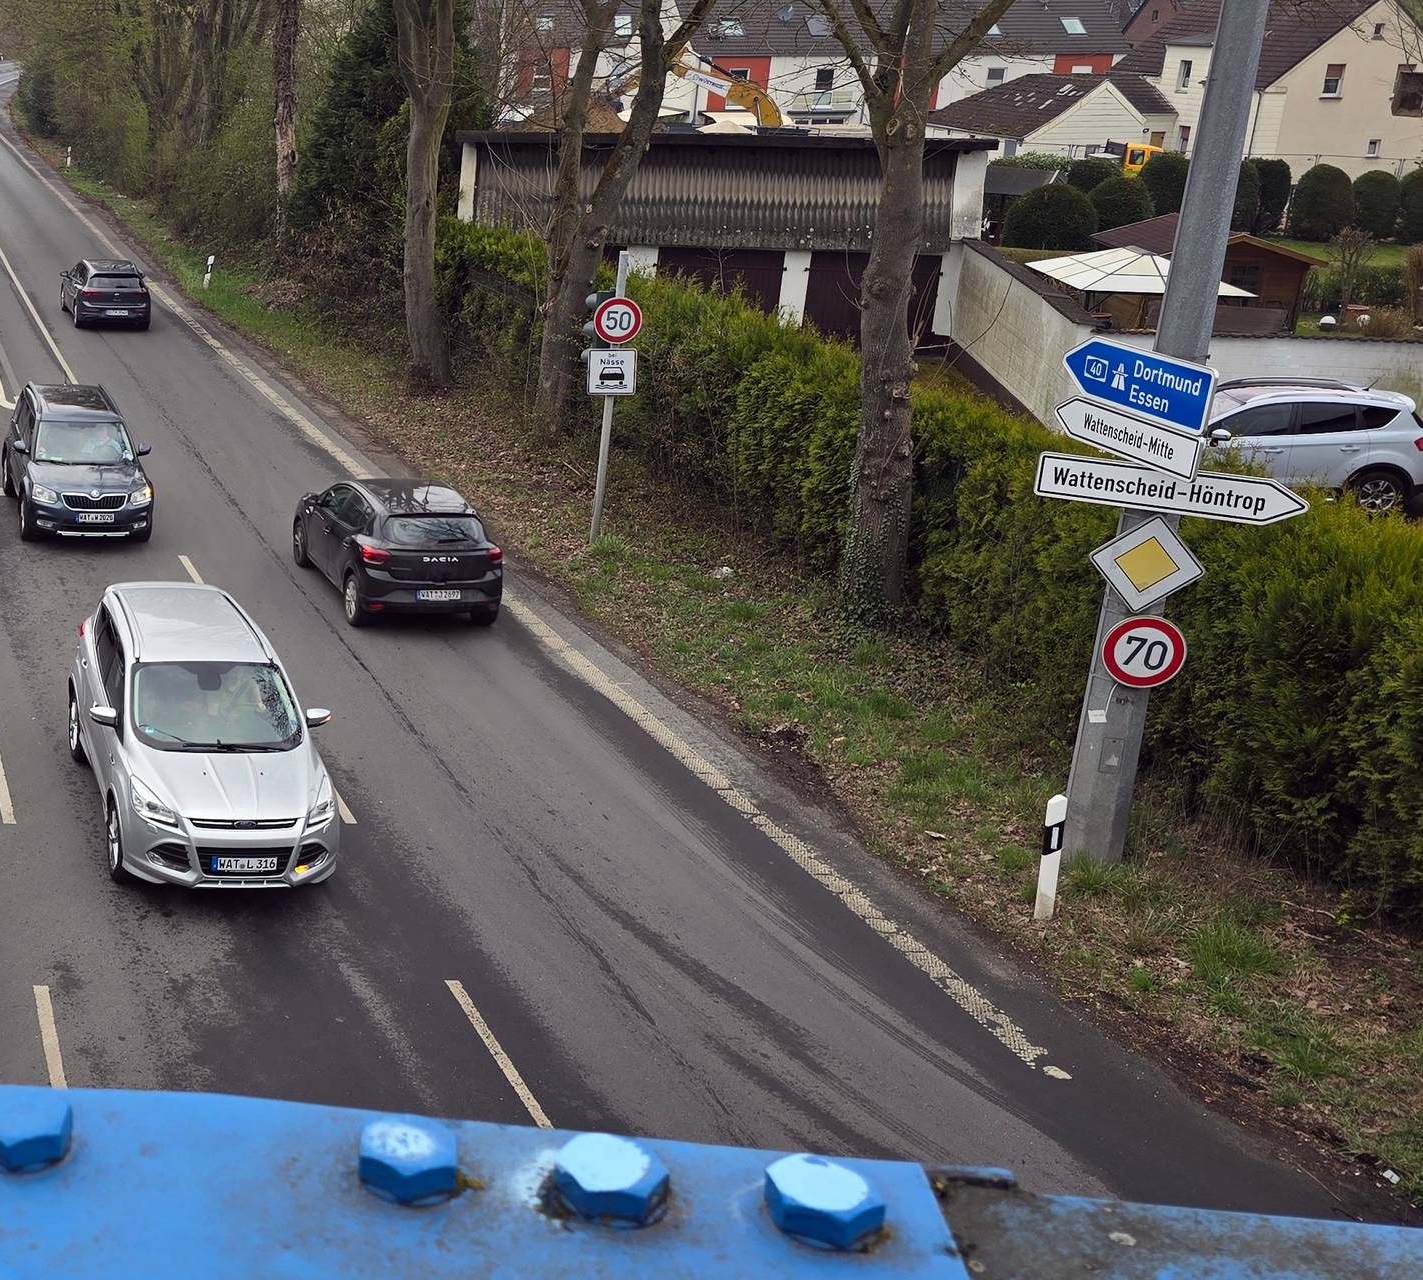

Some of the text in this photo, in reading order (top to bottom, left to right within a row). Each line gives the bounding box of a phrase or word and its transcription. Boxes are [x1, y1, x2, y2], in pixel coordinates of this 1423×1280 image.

[606, 311, 632, 330] 50
[1089, 361, 1102, 377] 40
[1133, 360, 1202, 396] Dortmund
[1129, 385, 1169, 413] Essen
[1083, 412, 1174, 460] Wattenscheid-Mitte
[1054, 466, 1265, 515] Wattenscheid-Höntrop
[1122, 635, 1168, 671] 70
[219, 859, 240, 869] WAT
[256, 859, 276, 869] 316
